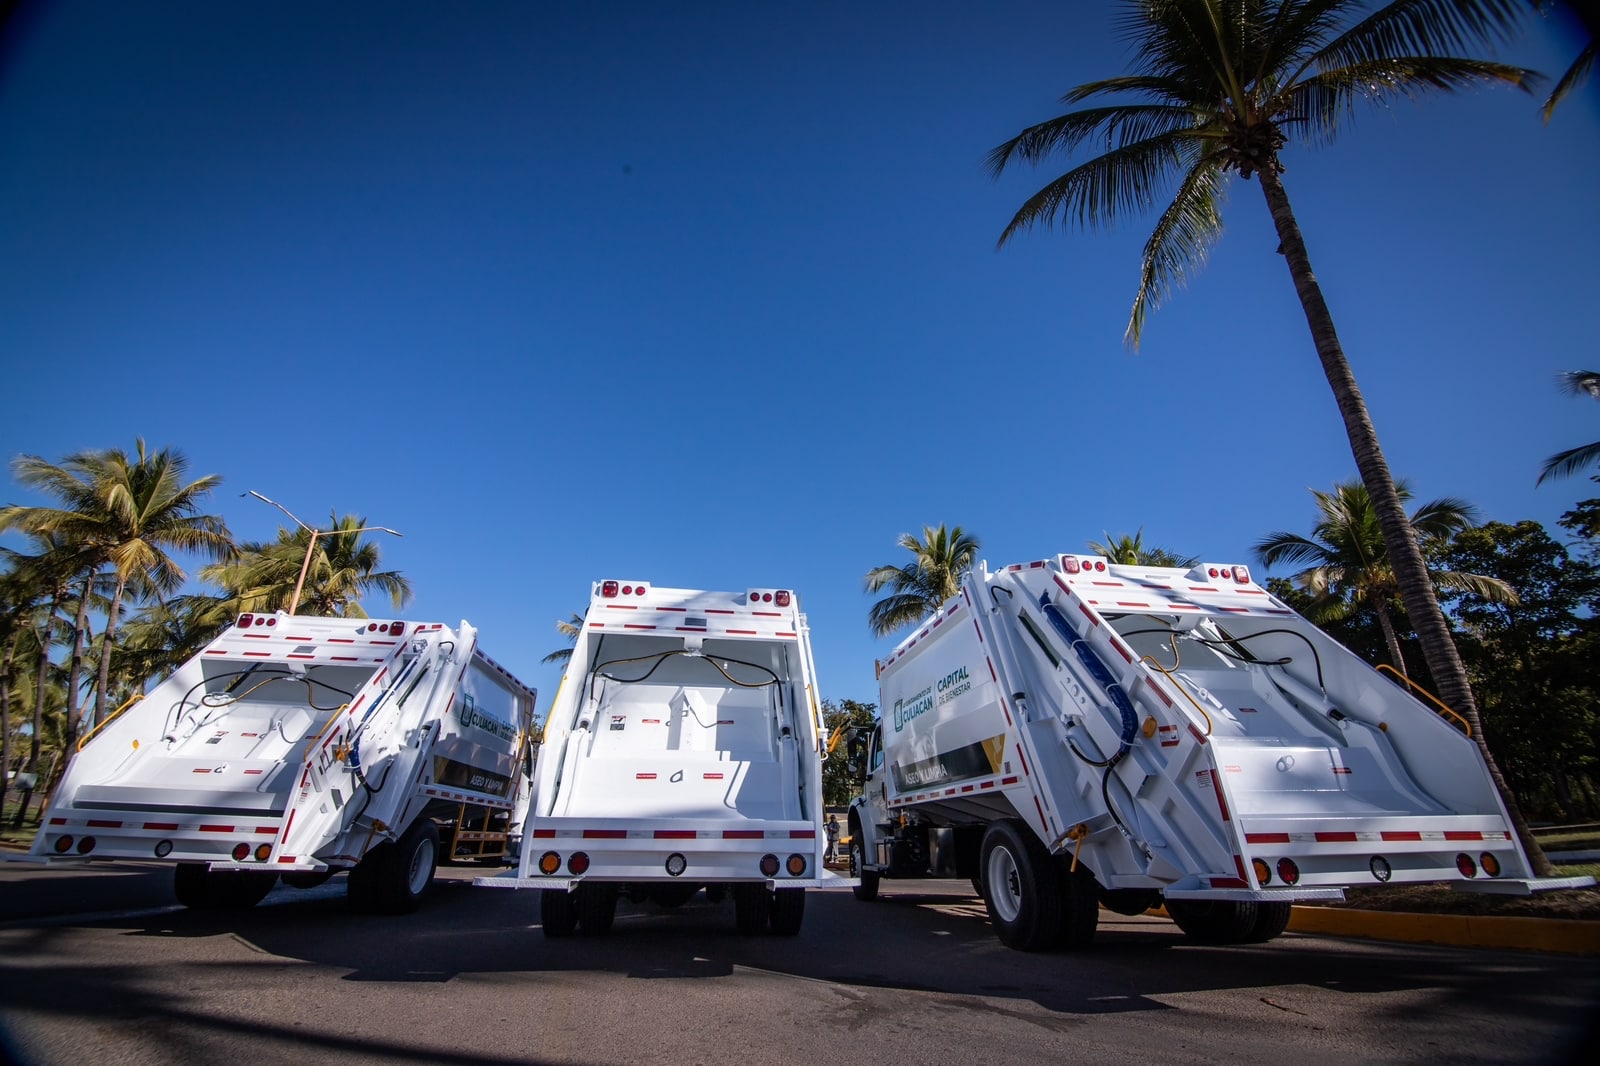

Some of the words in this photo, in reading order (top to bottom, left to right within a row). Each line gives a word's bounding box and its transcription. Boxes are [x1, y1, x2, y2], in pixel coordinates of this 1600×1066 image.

[938, 665, 969, 692] CAPITAL
[946, 681, 971, 702] BIENESTAR
[470, 774, 485, 787] ASEO
[905, 770, 919, 785] ASEO
[924, 763, 948, 781] LIMPIA
